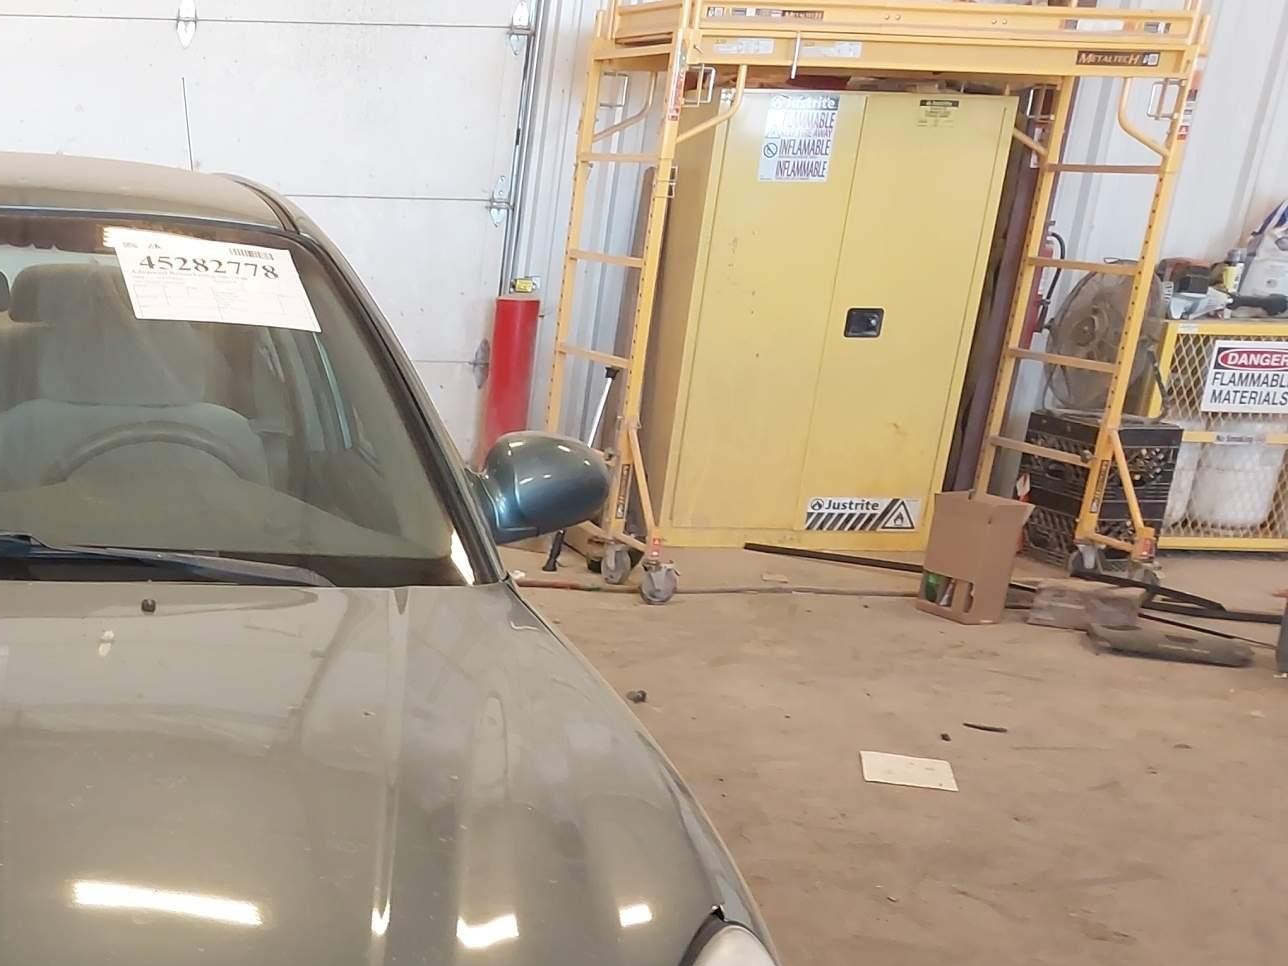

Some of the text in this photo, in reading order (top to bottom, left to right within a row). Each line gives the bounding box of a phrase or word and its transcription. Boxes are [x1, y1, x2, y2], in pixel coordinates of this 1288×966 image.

[779, 139, 831, 156] INFLAMABLE
[775, 161, 827, 177] INFLAMMABLE
[139, 255, 279, 280] 45282778
[825, 499, 879, 510] Justrite
